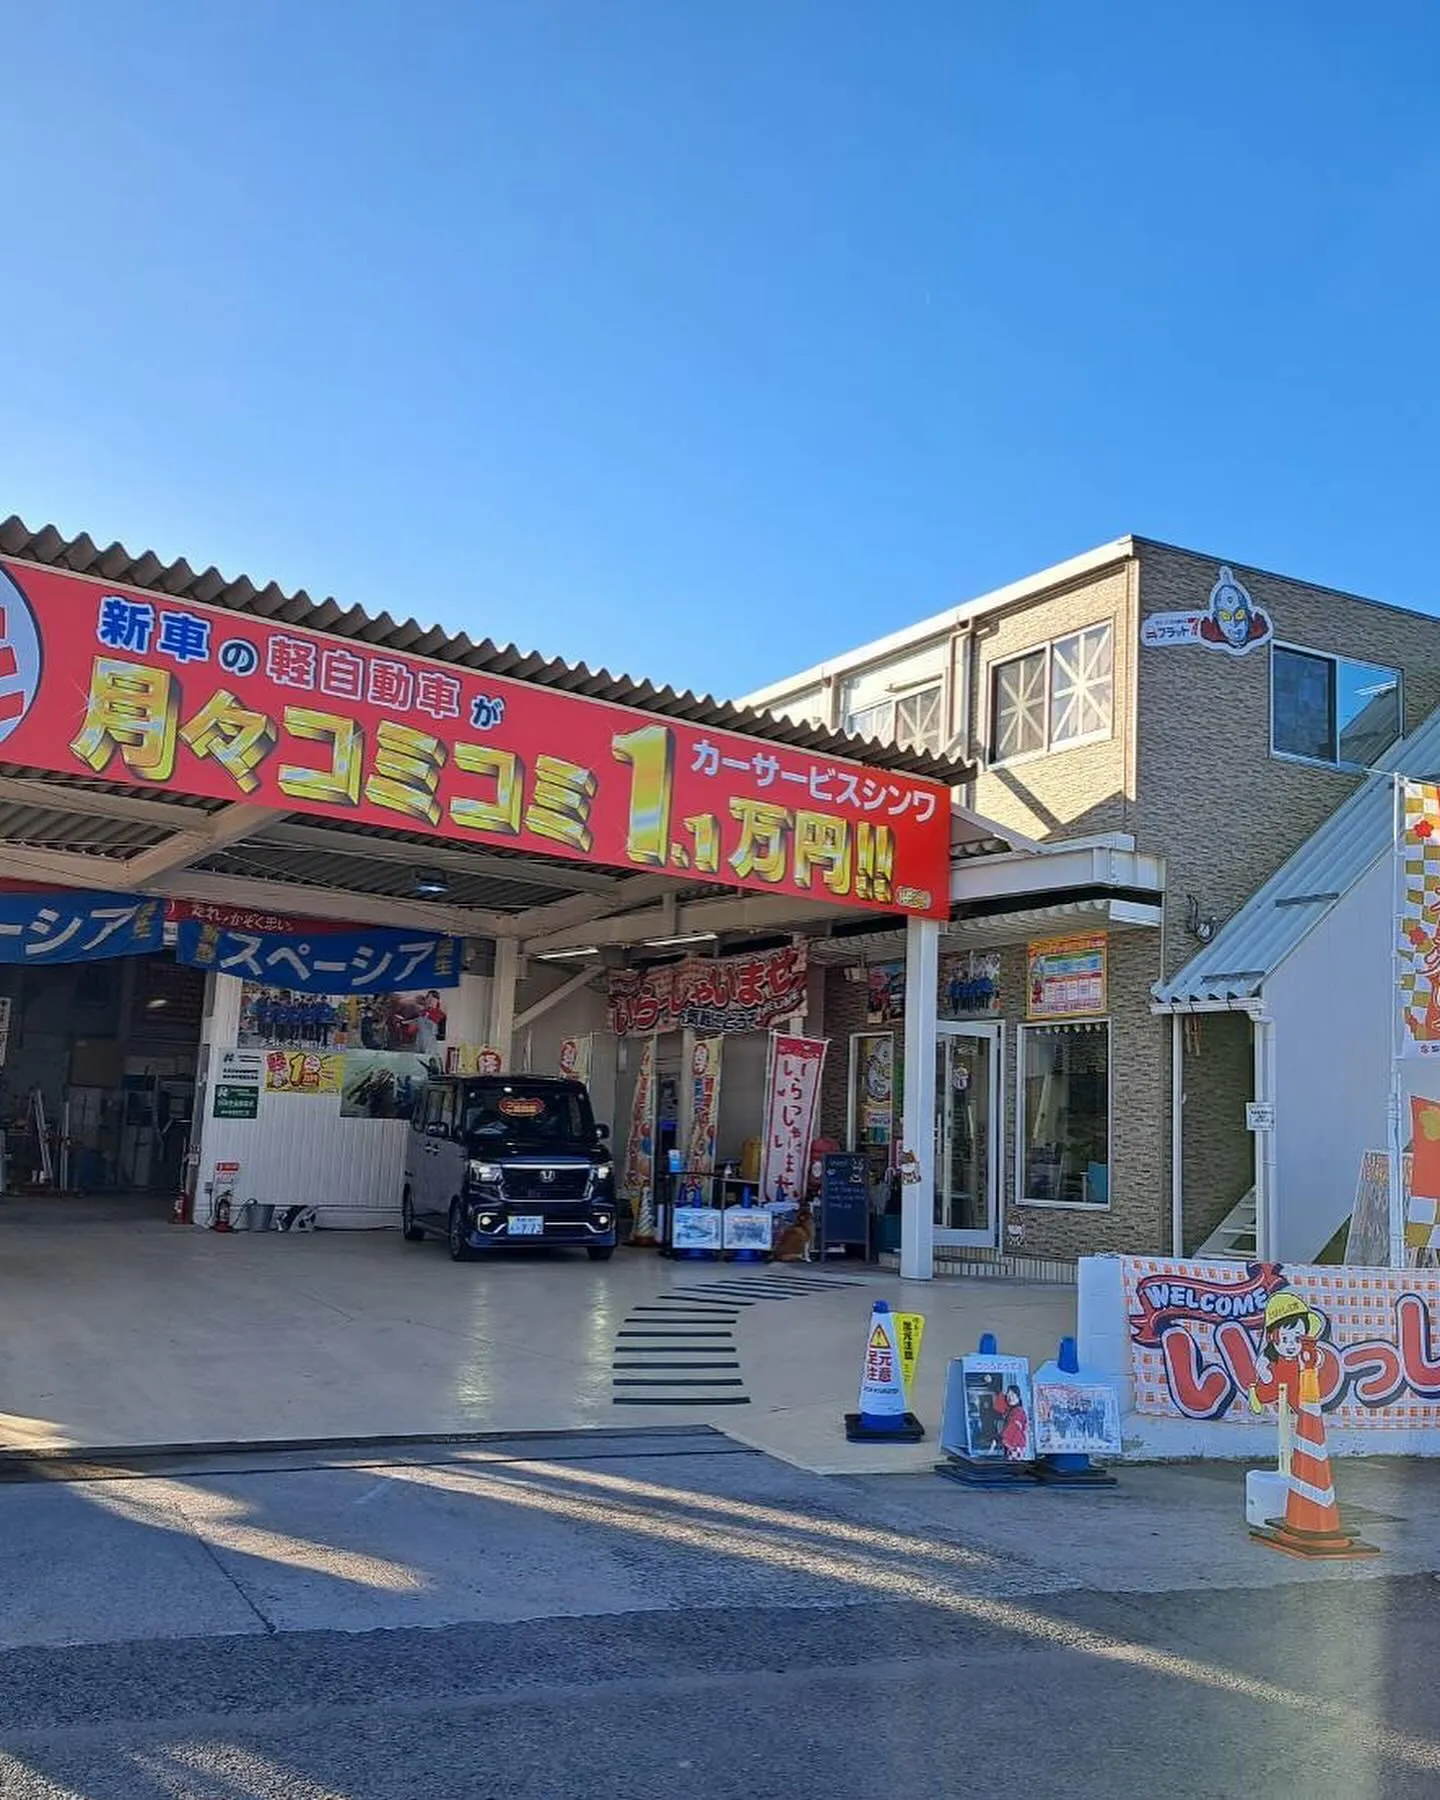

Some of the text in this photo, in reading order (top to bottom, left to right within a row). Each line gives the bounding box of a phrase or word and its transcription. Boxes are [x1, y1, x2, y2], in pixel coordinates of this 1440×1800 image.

[97, 595, 506, 731] 新車の軽自動車が
[690, 738, 937, 823] カーサービスシンワ
[219, 931, 437, 987] スペーシア
[1143, 1283, 1269, 1317] WELCOME
[867, 1365, 892, 1383] 注意
[868, 1350, 892, 1366] 足元
